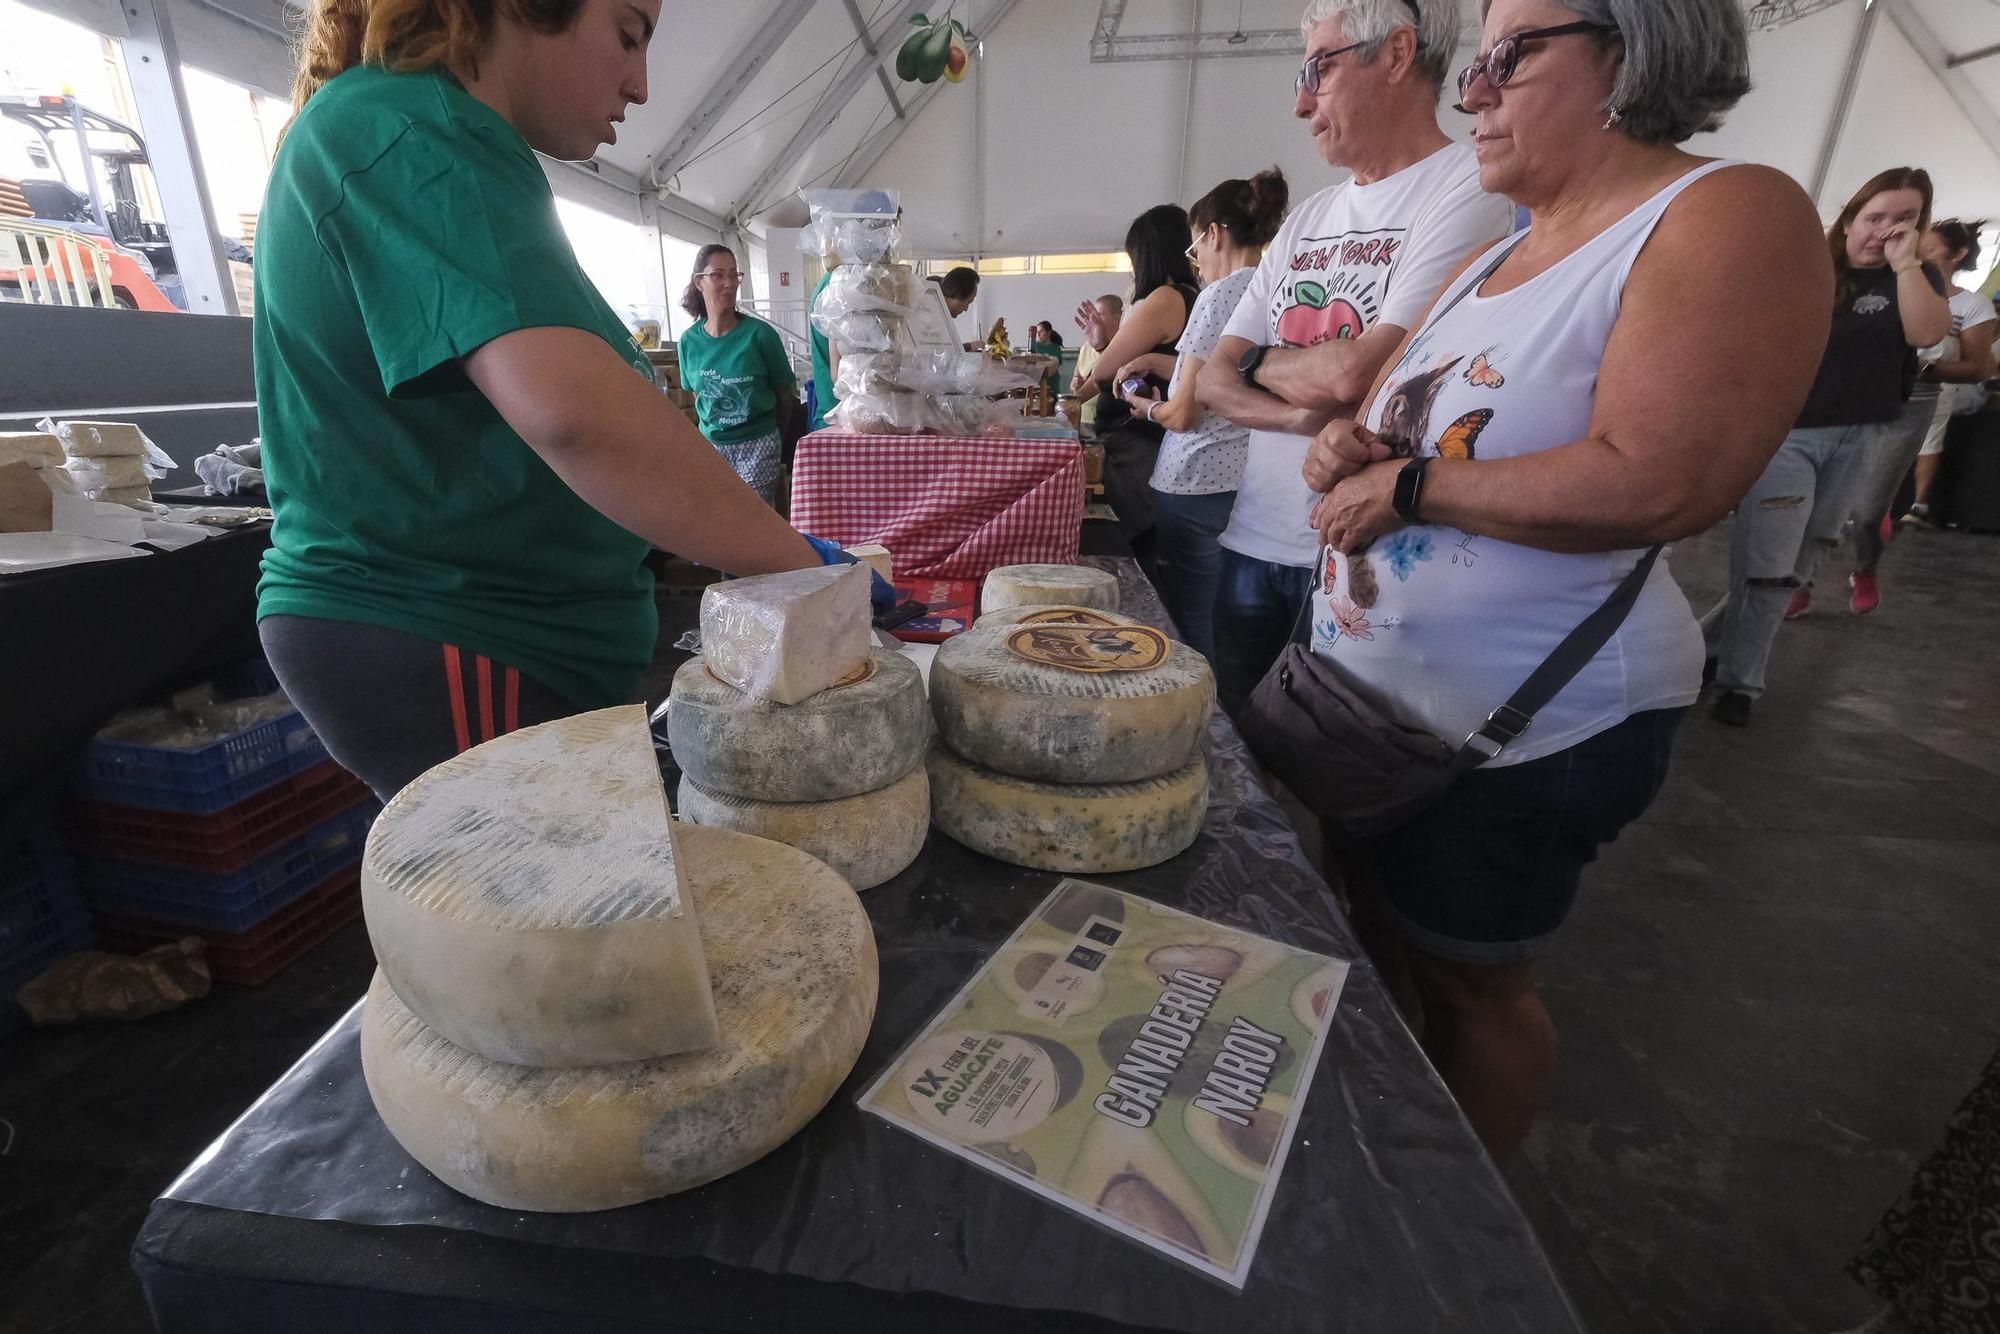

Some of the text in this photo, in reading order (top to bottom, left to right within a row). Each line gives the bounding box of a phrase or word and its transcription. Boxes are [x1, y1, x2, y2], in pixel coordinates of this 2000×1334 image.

[1290, 237, 1401, 271] NEW YORK
[910, 1036, 981, 1098] IX FERIA DEL
[934, 1038, 1005, 1116] AGUACATE
[1094, 969, 1224, 1128] GANADERÍA
[1192, 1016, 1284, 1126] NAROY
